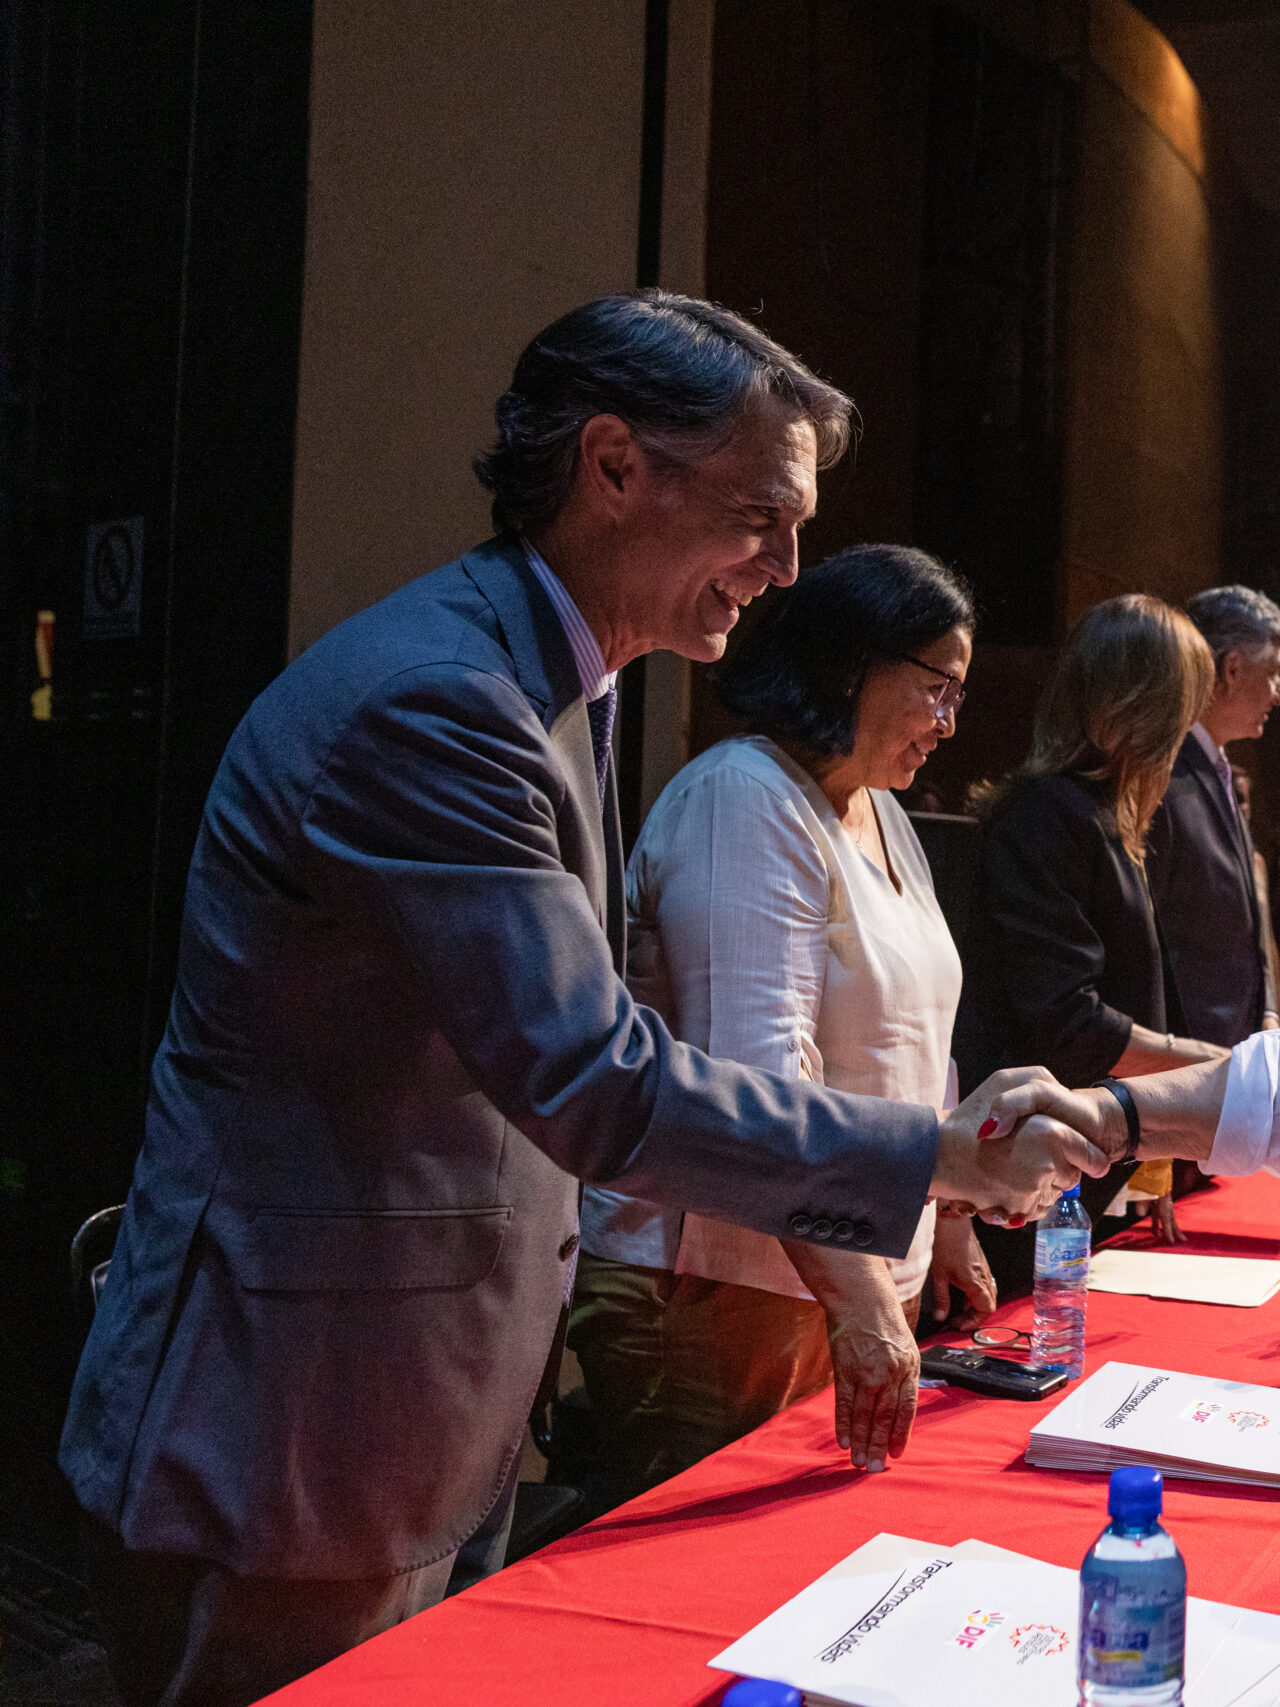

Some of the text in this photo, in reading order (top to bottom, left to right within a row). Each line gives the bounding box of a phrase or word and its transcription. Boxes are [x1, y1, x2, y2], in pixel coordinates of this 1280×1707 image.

[1121, 1376, 1170, 1413] Transformando
[858, 1559, 953, 1633] Transformando
[955, 1626, 986, 1649] DIF
